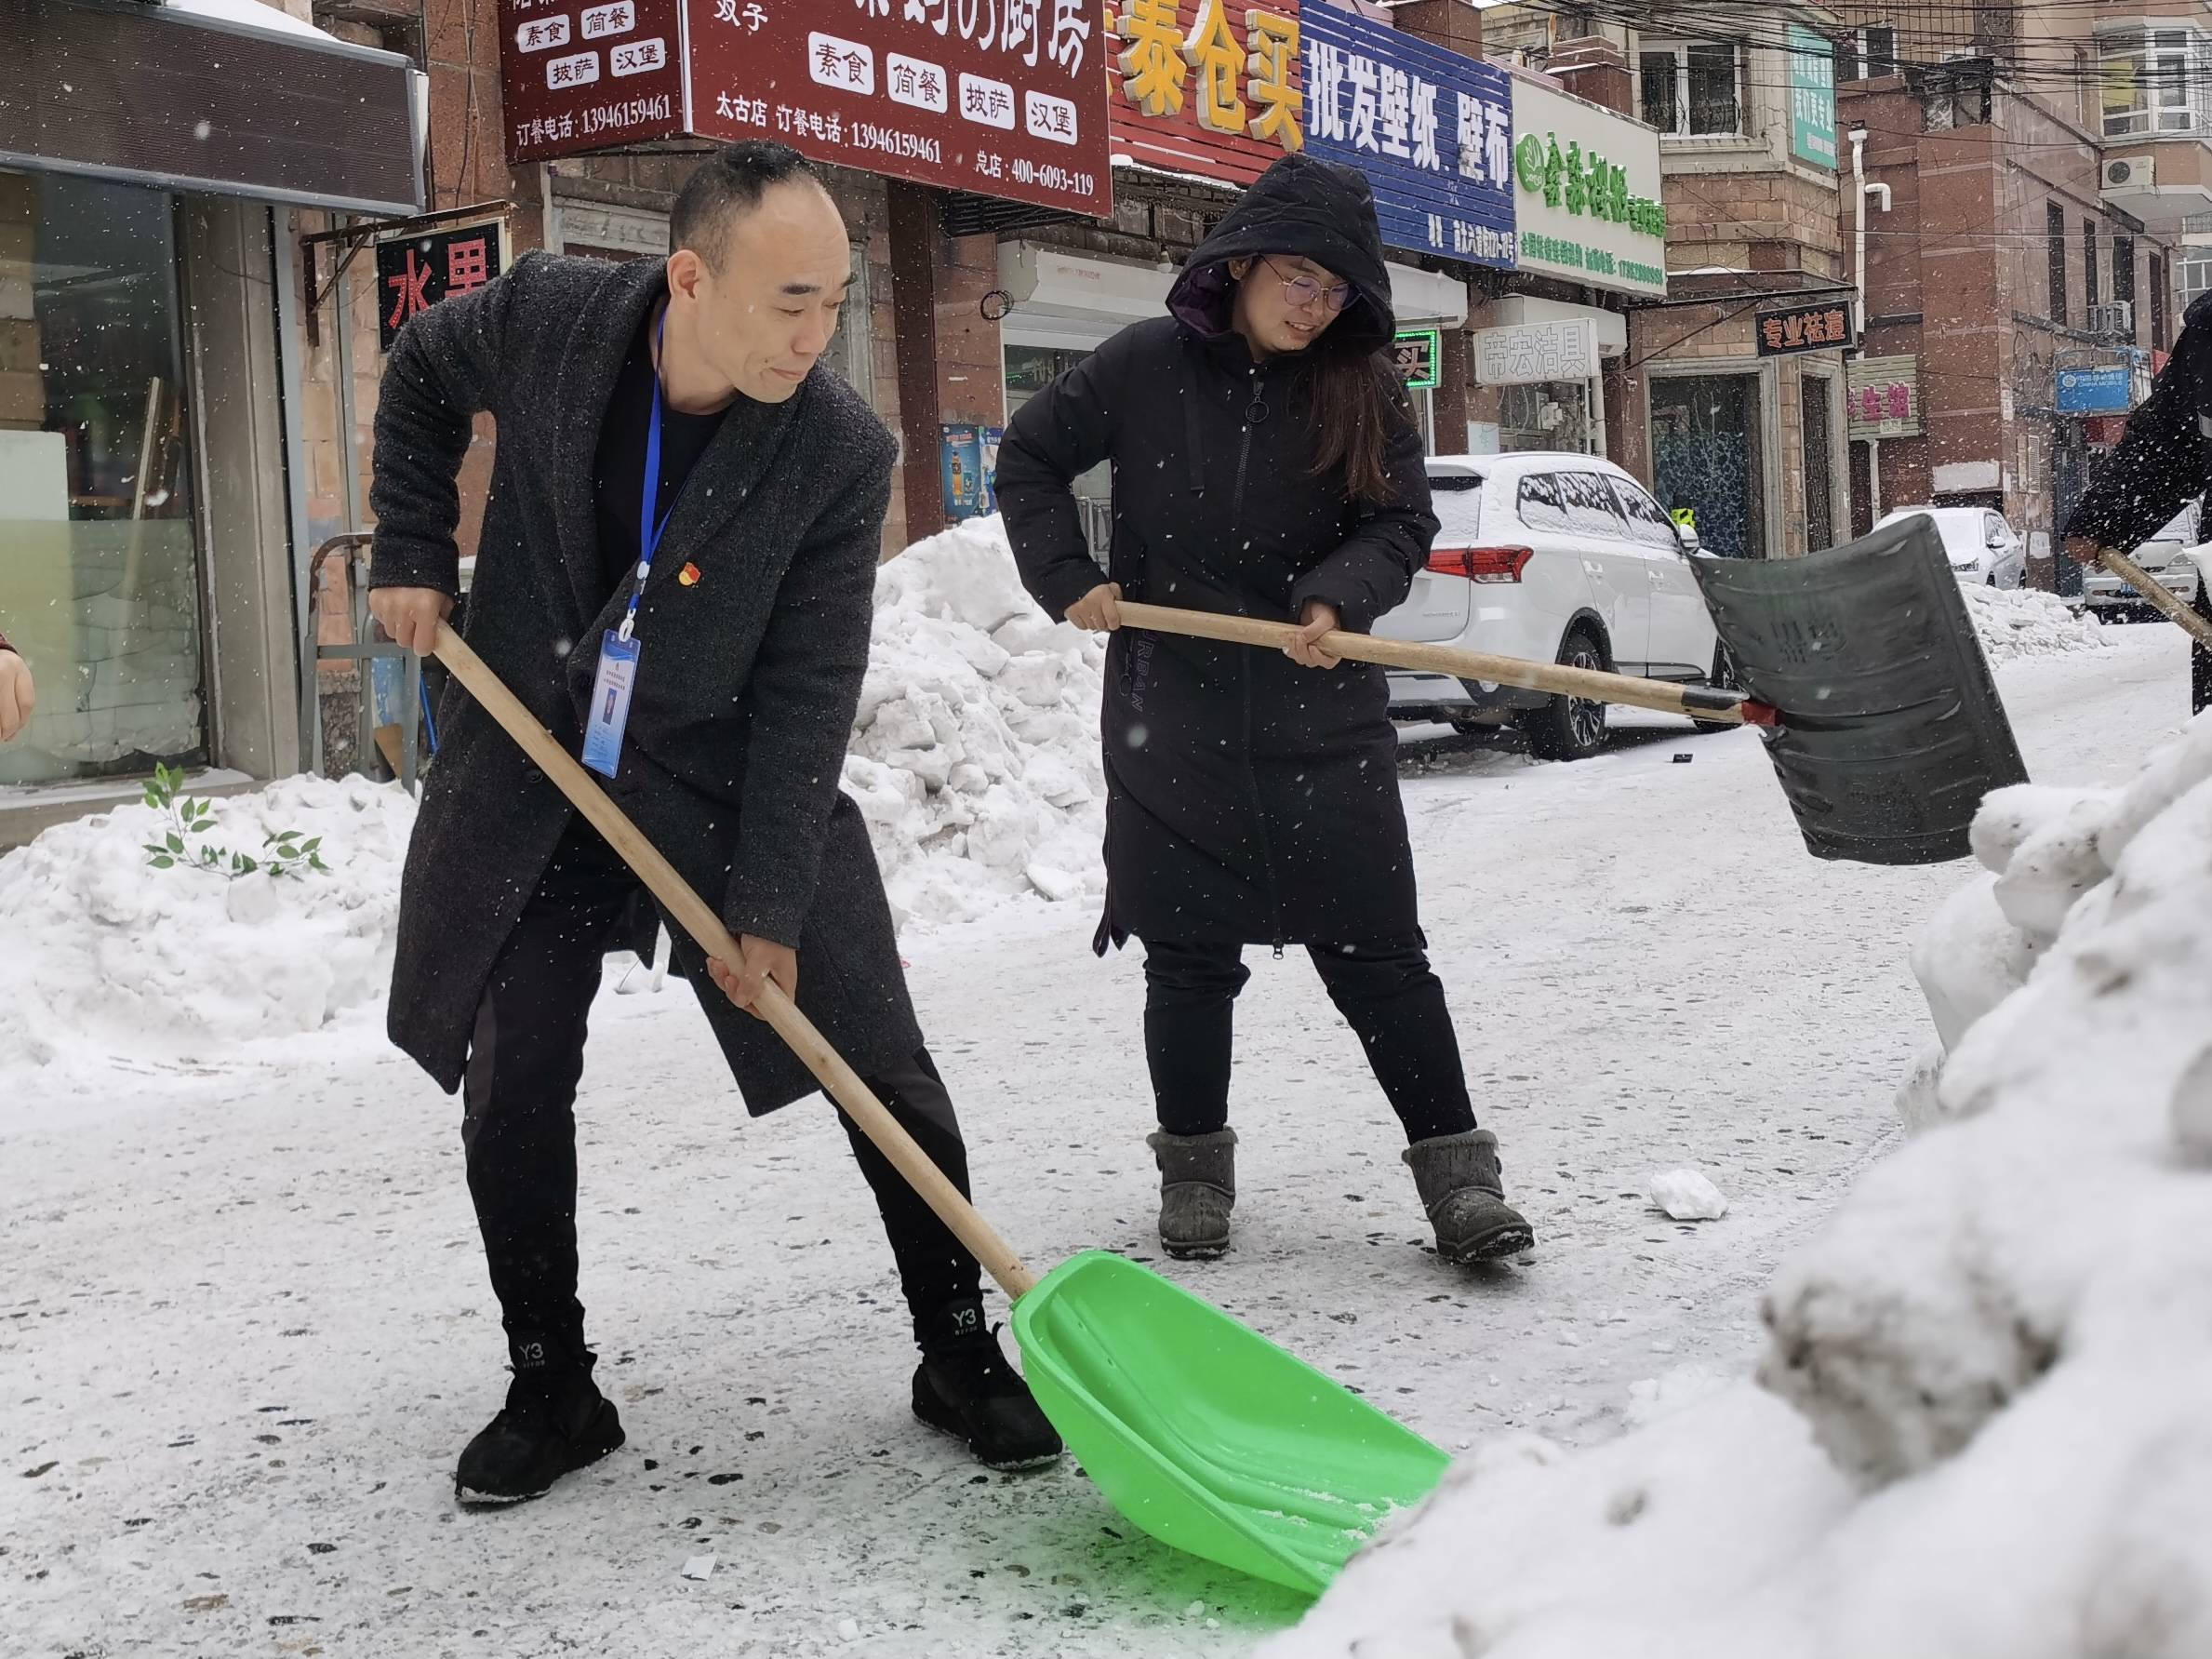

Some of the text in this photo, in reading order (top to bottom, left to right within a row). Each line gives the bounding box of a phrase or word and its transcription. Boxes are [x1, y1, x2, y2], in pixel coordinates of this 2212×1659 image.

[525, 20, 566, 47] 素食
[585, 6, 630, 34] 简餐
[552, 57, 595, 85] 披萨
[616, 44, 660, 71] 汉堡
[1104, 0, 1304, 152] 泰仓买
[815, 42, 1073, 137] 素食 简餐 披萨 汉堡
[715, 90, 768, 127] 太古店
[1457, 90, 1510, 190] 壁布
[1763, 308, 1846, 349] 专业祛痘
[1394, 340, 1430, 381] 买
[1485, 326, 1586, 381] 帝宏洁具
[952, 1308, 977, 1328] Y3
[518, 1342, 544, 1360] Y3
